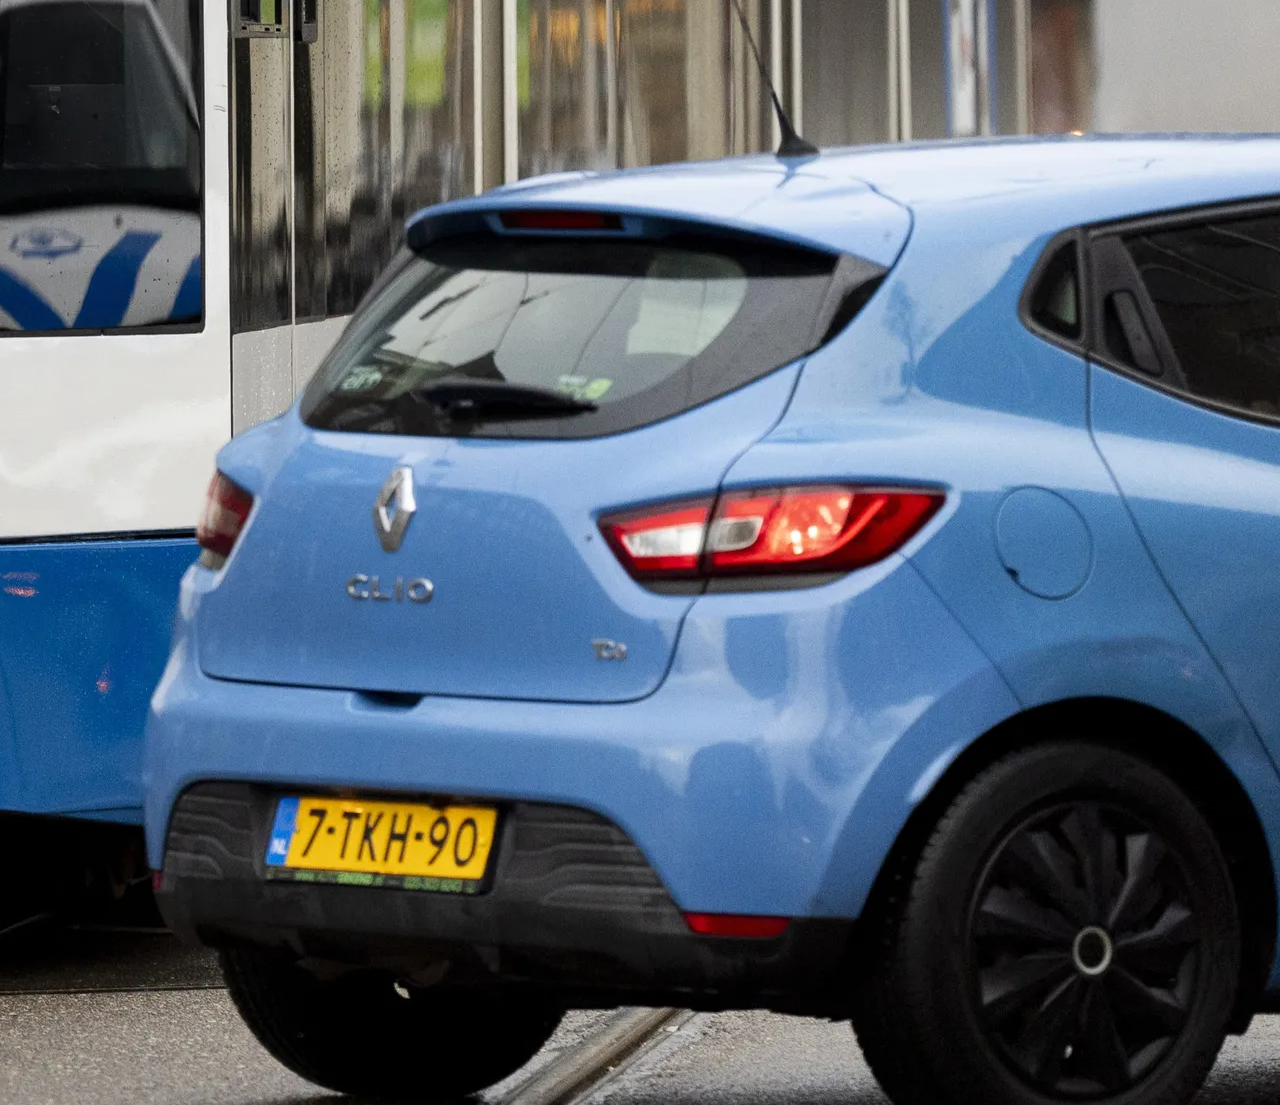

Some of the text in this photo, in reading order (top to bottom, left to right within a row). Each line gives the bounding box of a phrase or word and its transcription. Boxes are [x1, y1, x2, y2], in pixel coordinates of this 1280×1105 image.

[346, 573, 434, 603] CLIO
[270, 808, 480, 868] NL 7-TKH-90
